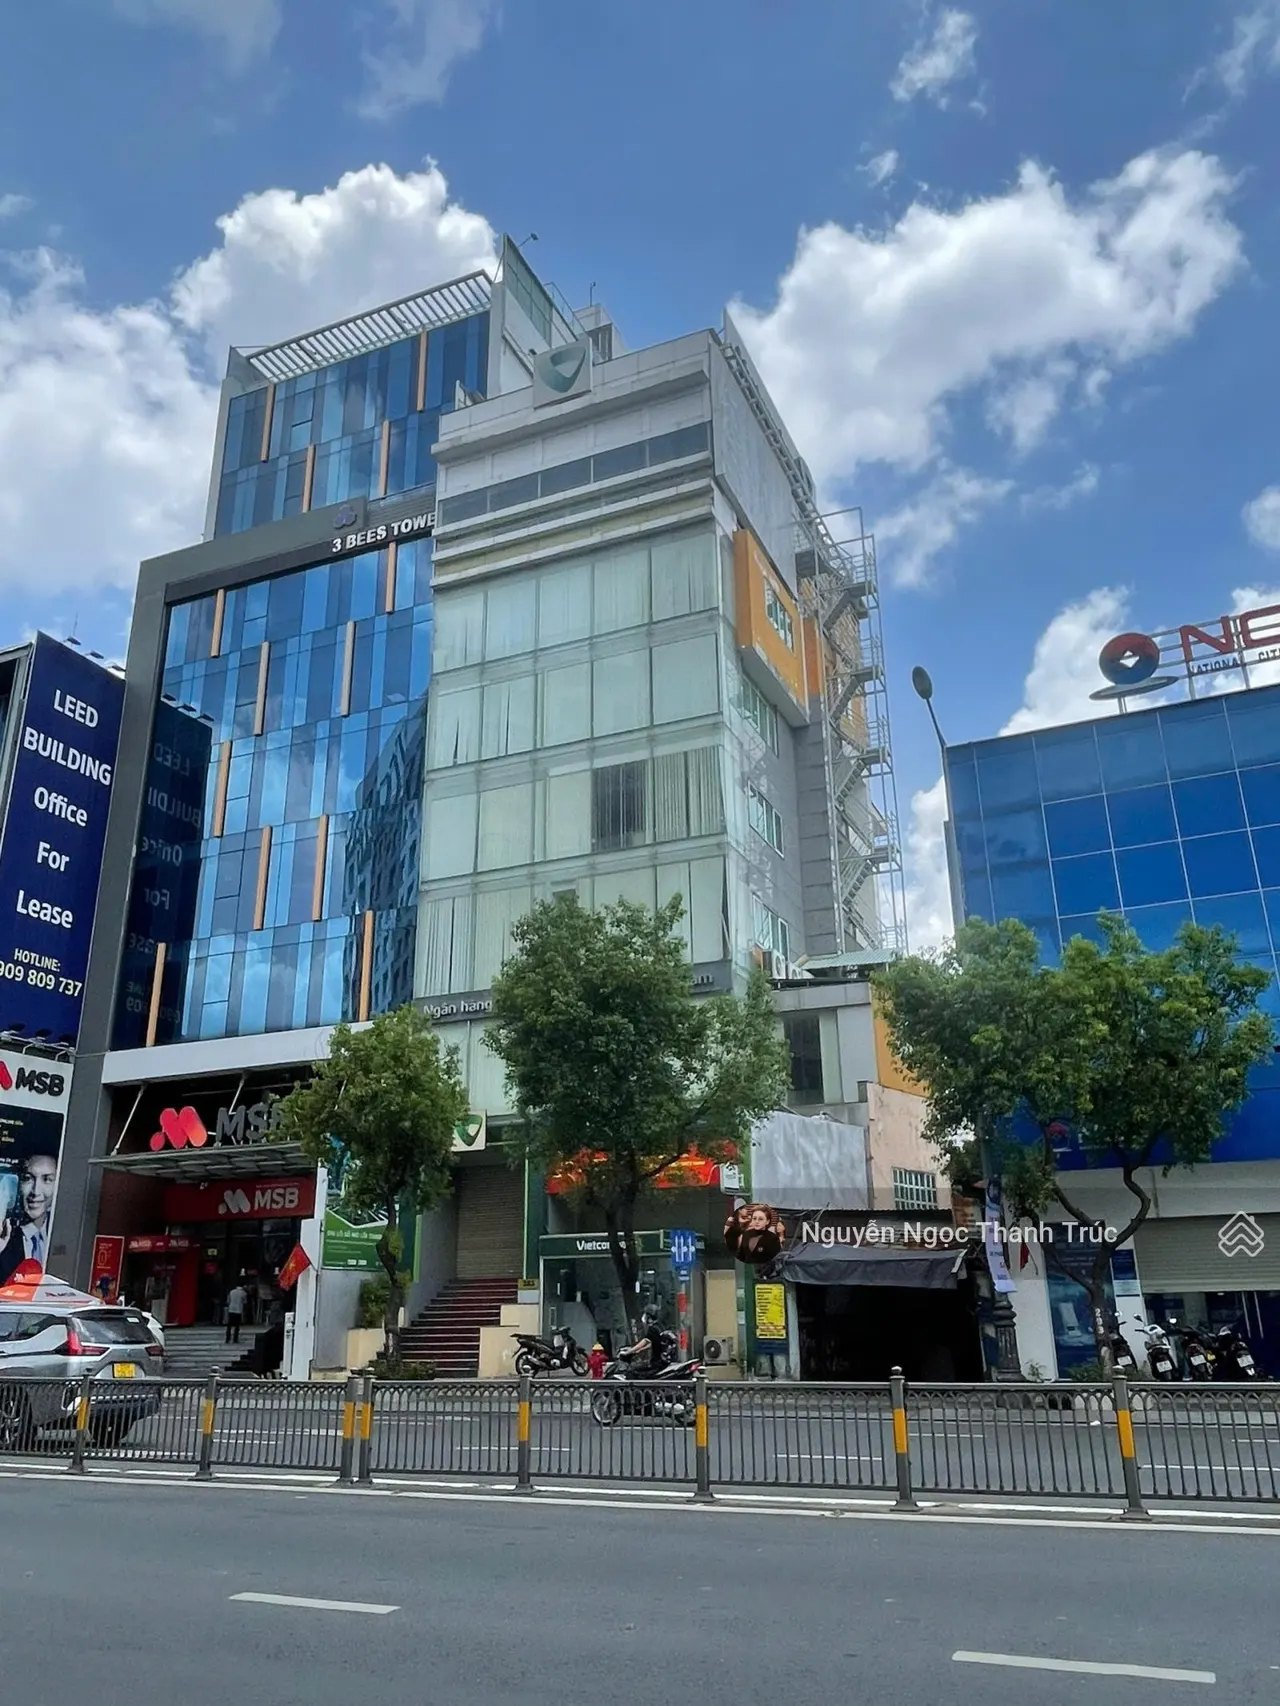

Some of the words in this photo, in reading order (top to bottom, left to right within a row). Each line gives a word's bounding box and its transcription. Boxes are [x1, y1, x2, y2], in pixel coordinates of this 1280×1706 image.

[331, 538, 342, 553] 3
[345, 525, 387, 550] BEES
[391, 513, 436, 535] TOWE
[1190, 656, 1240, 675] ATIONA
[53, 689, 99, 728] LEED
[23, 726, 112, 786] BUILDING
[34, 787, 88, 827] Office
[37, 841, 70, 872] For
[16, 889, 73, 929] Lease
[14, 948, 61, 973] HOTLINE:
[27, 969, 56, 990] 809
[58, 977, 83, 997] 737
[15, 1066, 65, 1097] MSB
[253, 1186, 299, 1211] MSB
